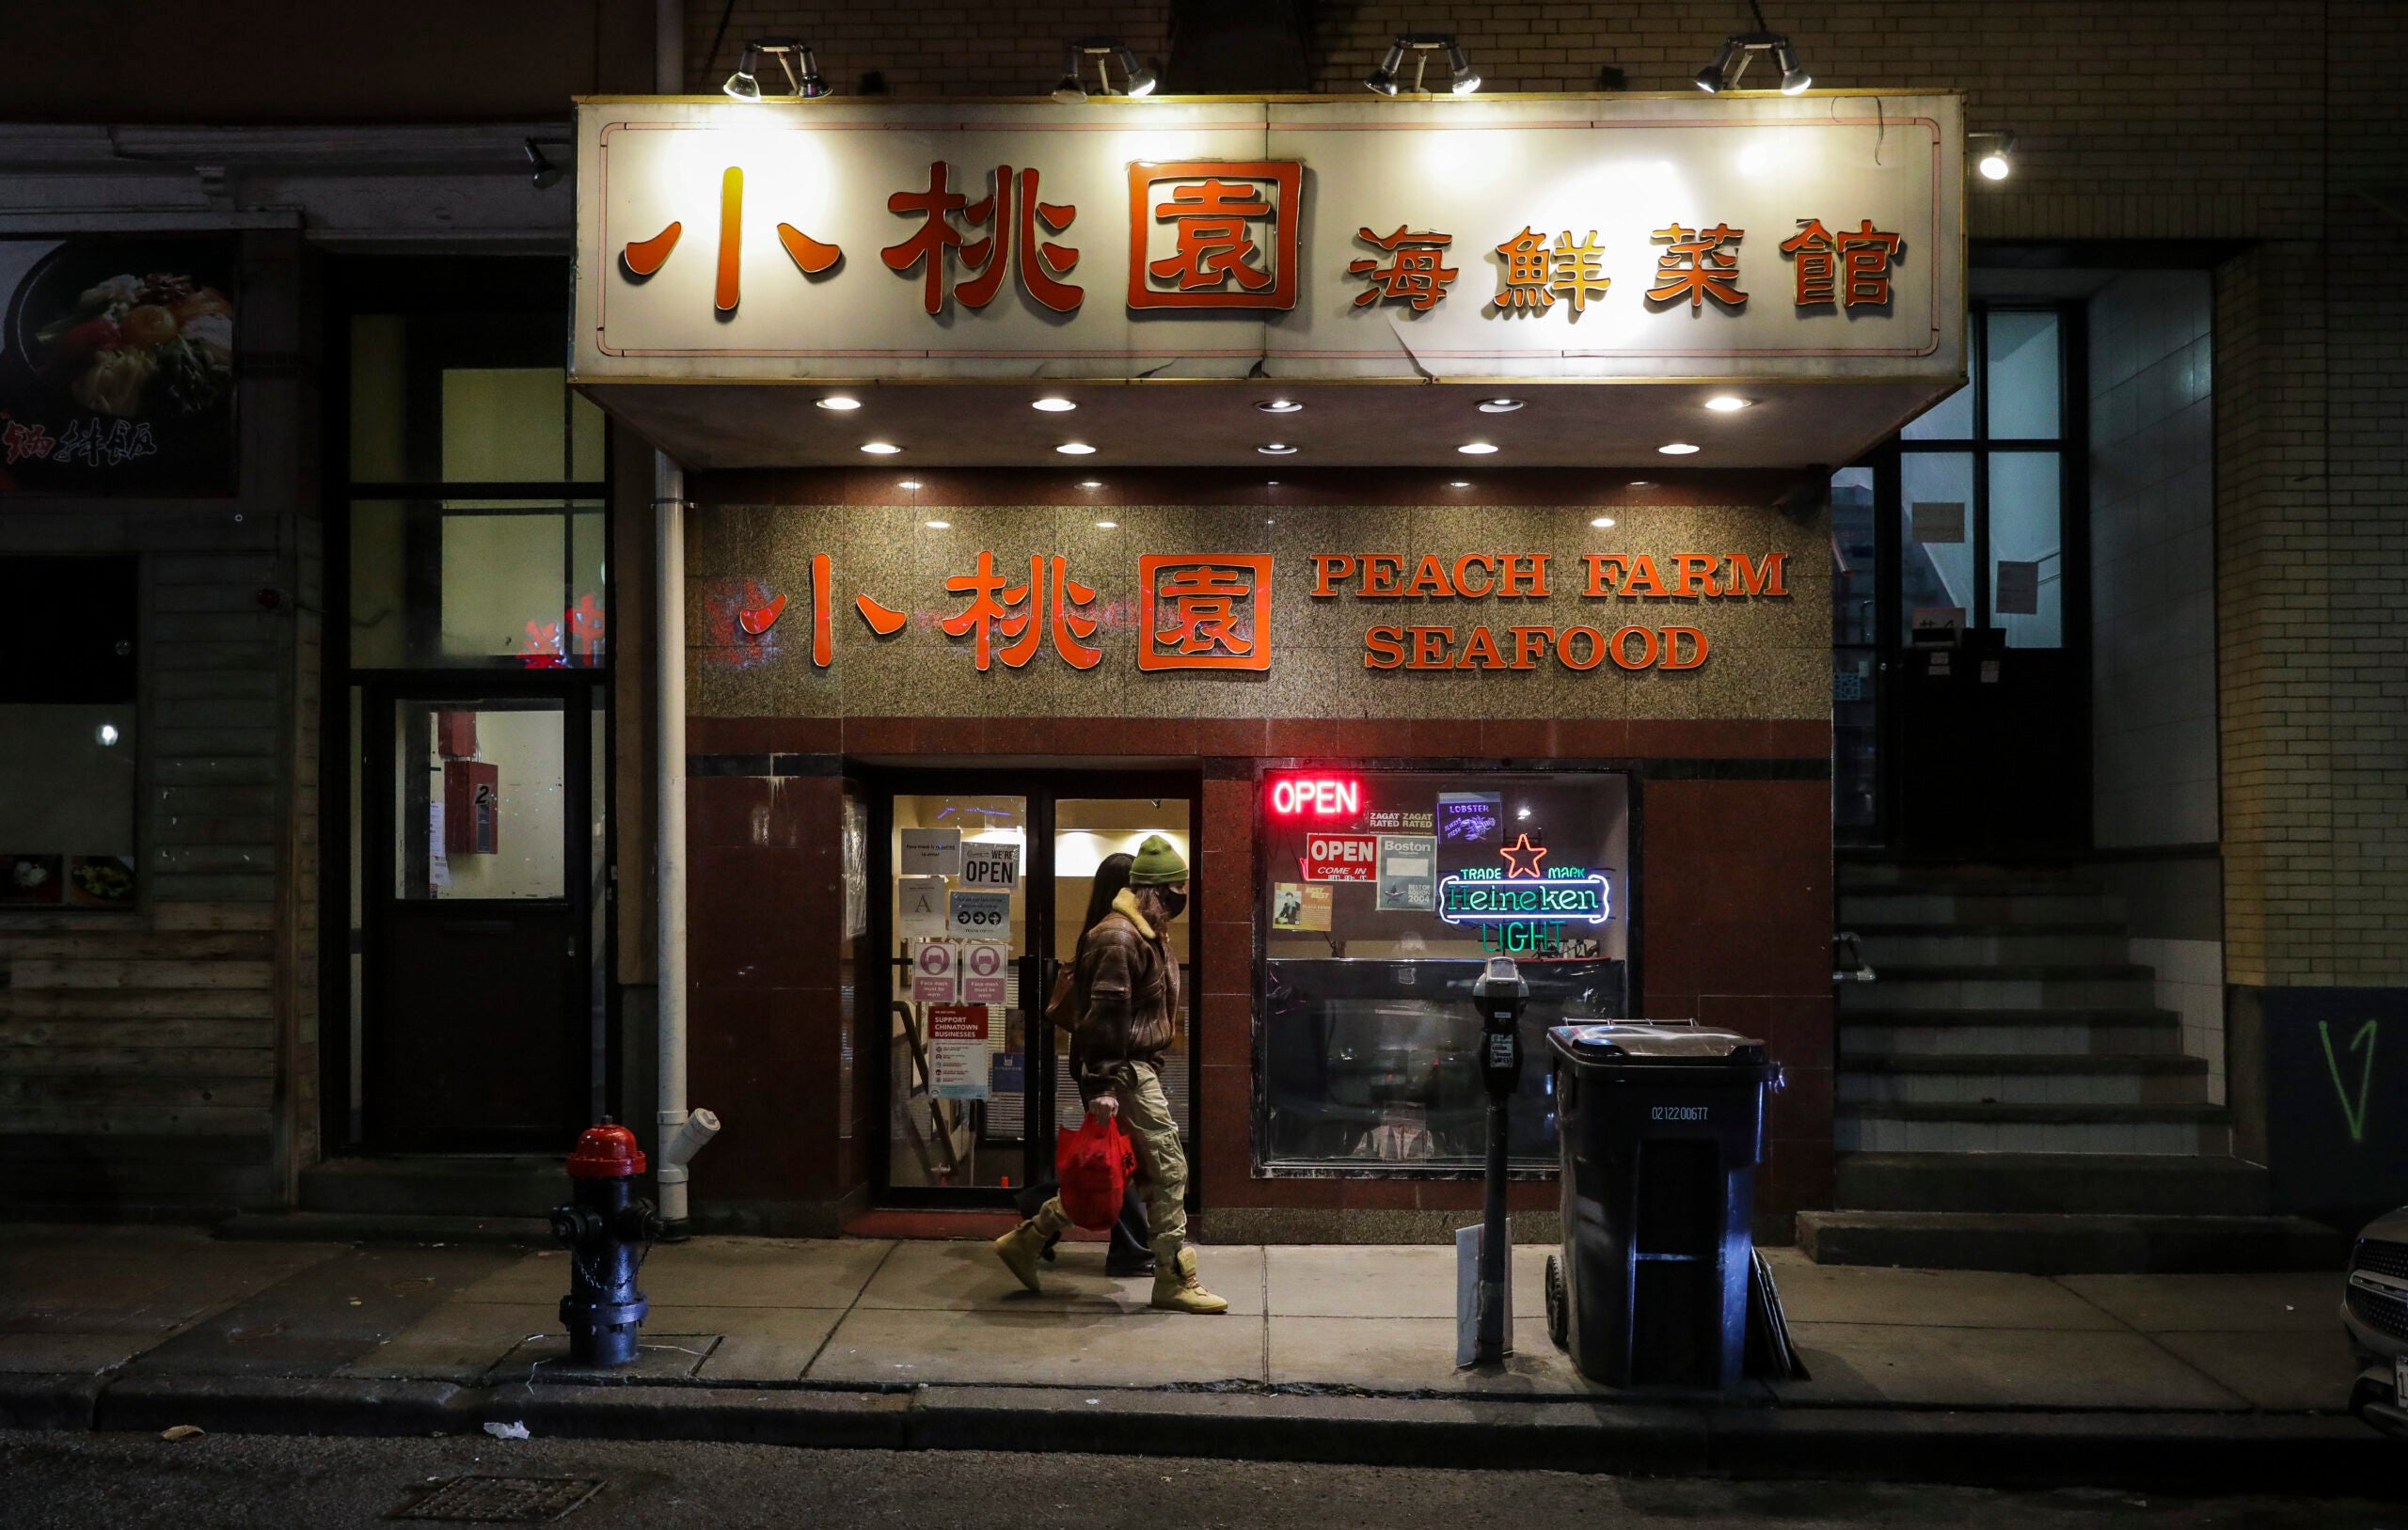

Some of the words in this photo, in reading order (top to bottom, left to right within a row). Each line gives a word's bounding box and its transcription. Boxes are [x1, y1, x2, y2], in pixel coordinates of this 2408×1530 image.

[625, 161, 1303, 314] 小桃園
[1349, 218, 1905, 312] 海鮮菜館
[1310, 553, 1552, 598] PEACH
[1582, 553, 1789, 597] FARM
[739, 551, 1275, 672] 小桃園
[1364, 625, 1710, 670] SEAFOOD
[474, 785, 489, 805] 2
[1274, 781, 1358, 814] OPEN
[1402, 812, 1433, 821] ZAGAT
[1450, 804, 1489, 813] LOBSTER
[1402, 820, 1433, 828] RATED
[991, 850, 1013, 860] WE'RE
[1310, 840, 1373, 862] OPEN
[1384, 840, 1431, 852] Boston
[966, 860, 1013, 884] OPEN
[1460, 868, 1501, 880] TRADE
[1547, 867, 1585, 878] MARK
[915, 894, 932, 913] A
[1408, 894, 1430, 904] 2004
[1448, 885, 1599, 911] Heineken
[1481, 921, 1566, 953] LIGHT
